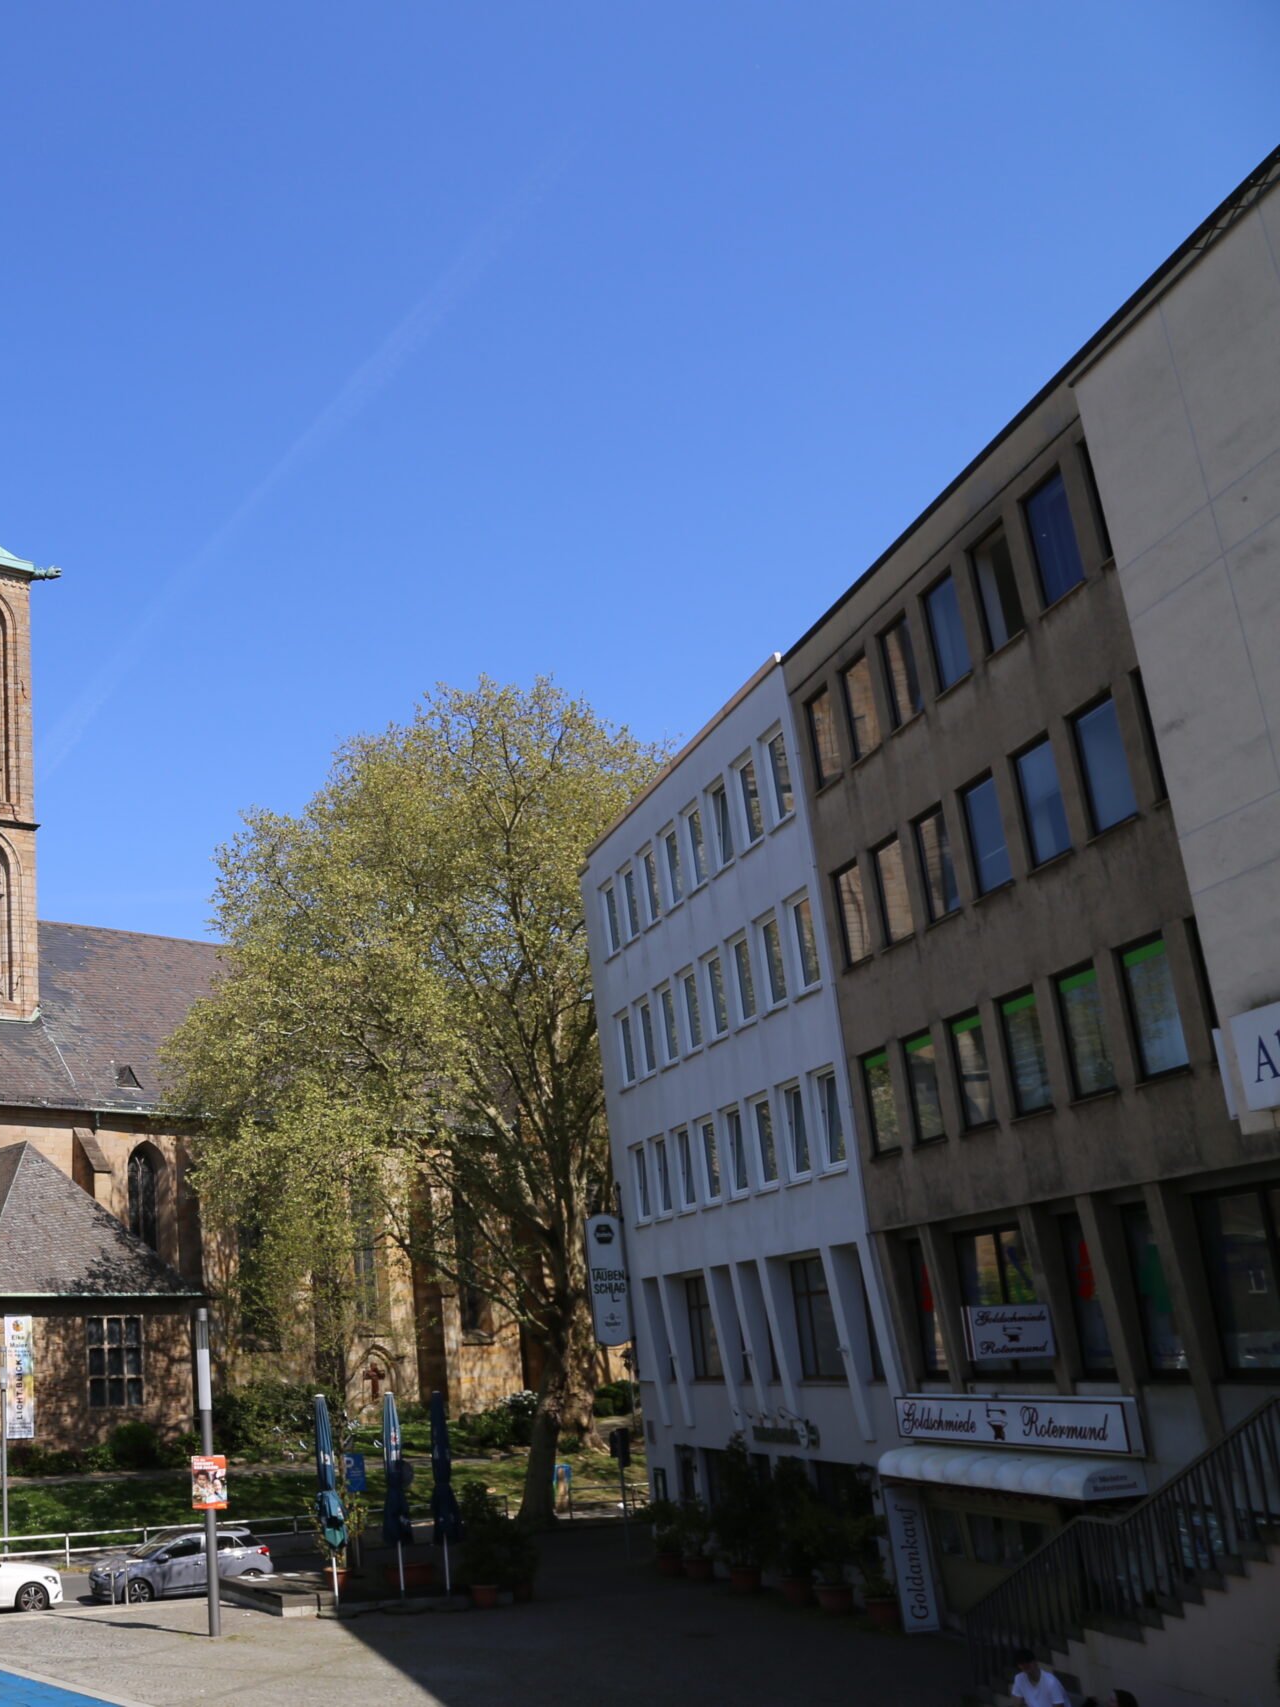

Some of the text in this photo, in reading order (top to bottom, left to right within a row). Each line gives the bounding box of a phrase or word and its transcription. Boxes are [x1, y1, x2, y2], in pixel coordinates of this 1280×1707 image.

[1254, 1028, 1280, 1083] A
[591, 1268, 625, 1281] TAUBEN
[593, 1281, 626, 1303] SCHLAG
[974, 1310, 1047, 1327] Goldschmiede
[979, 1340, 1049, 1355] Rotermund
[901, 1401, 1109, 1442] Goldschmiede Rotermund
[894, 1503, 929, 1620] Goldankauf
